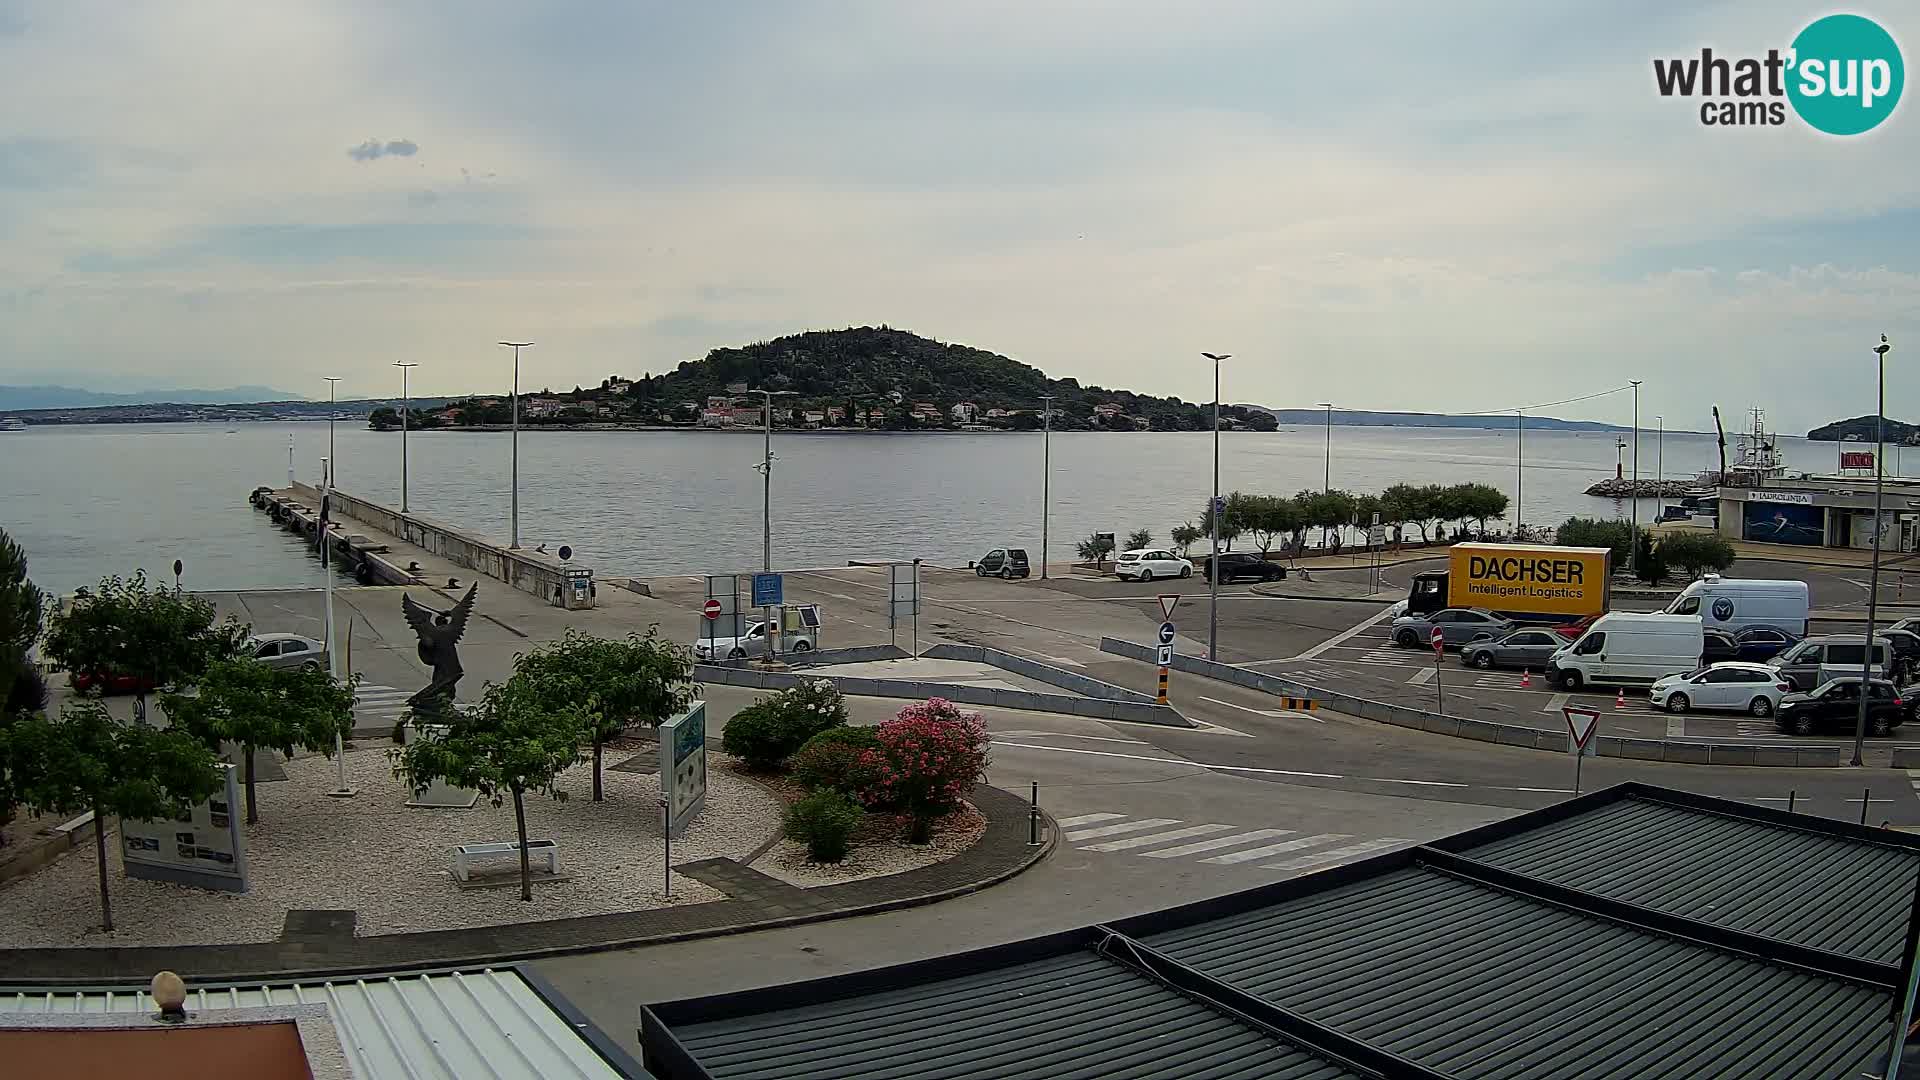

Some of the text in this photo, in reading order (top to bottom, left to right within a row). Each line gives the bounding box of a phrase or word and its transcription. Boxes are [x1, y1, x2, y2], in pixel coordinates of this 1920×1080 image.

[1470, 556, 1584, 584] DACHSER
[1469, 583, 1583, 600] Intelligent Logistics
